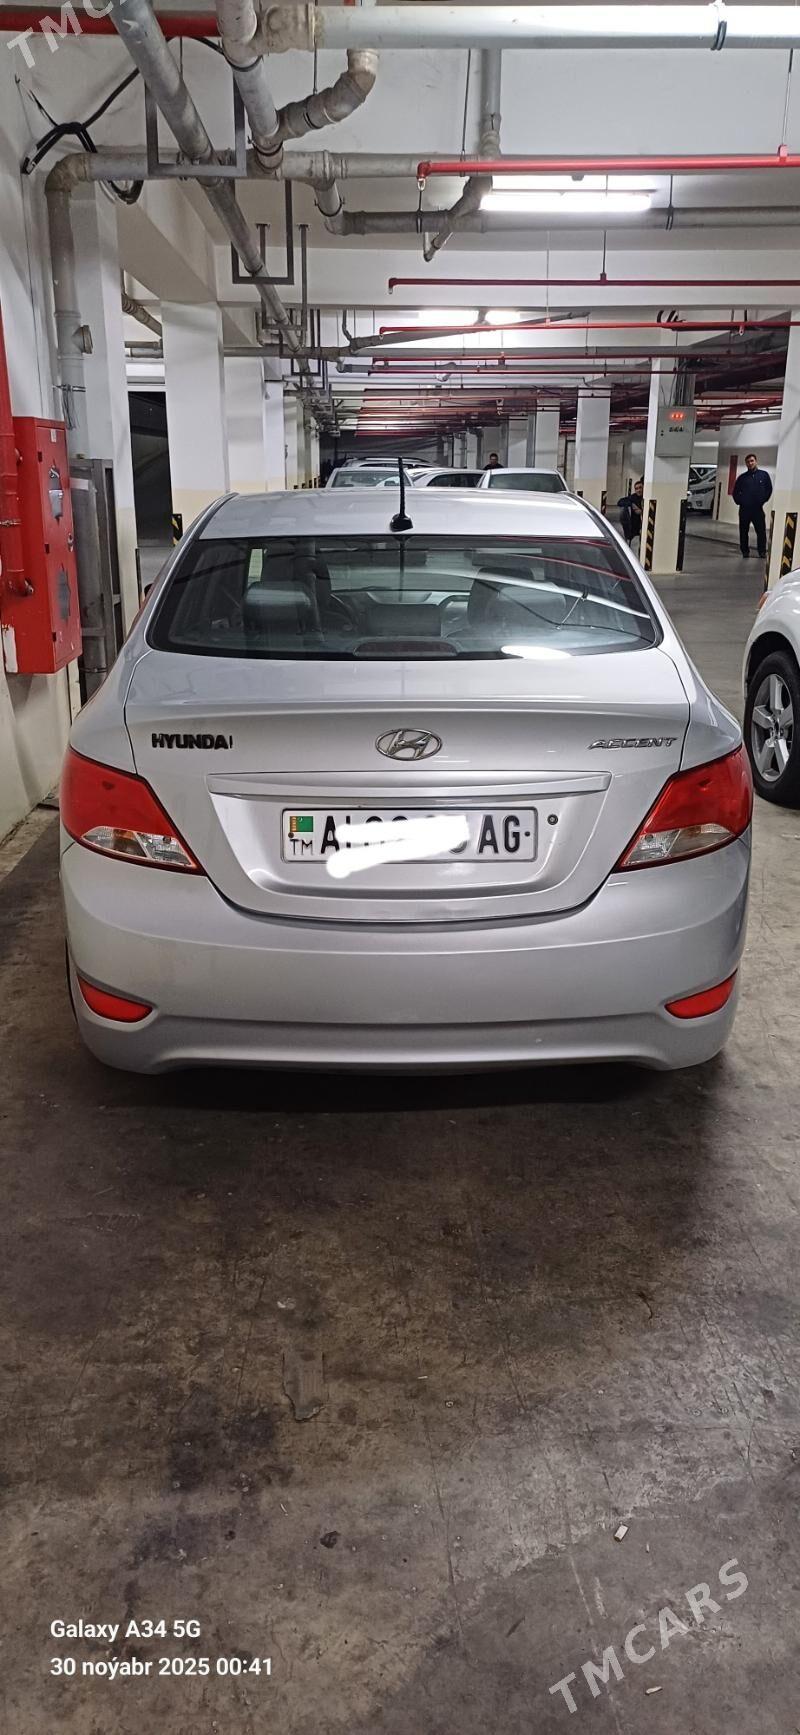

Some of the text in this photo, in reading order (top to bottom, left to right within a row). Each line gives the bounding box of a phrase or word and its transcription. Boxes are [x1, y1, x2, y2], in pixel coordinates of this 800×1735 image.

[151, 733, 233, 750] HYUNDAI
[587, 737, 677, 750] ACCENT
[290, 839, 314, 855] TM
[478, 815, 521, 854] AG
